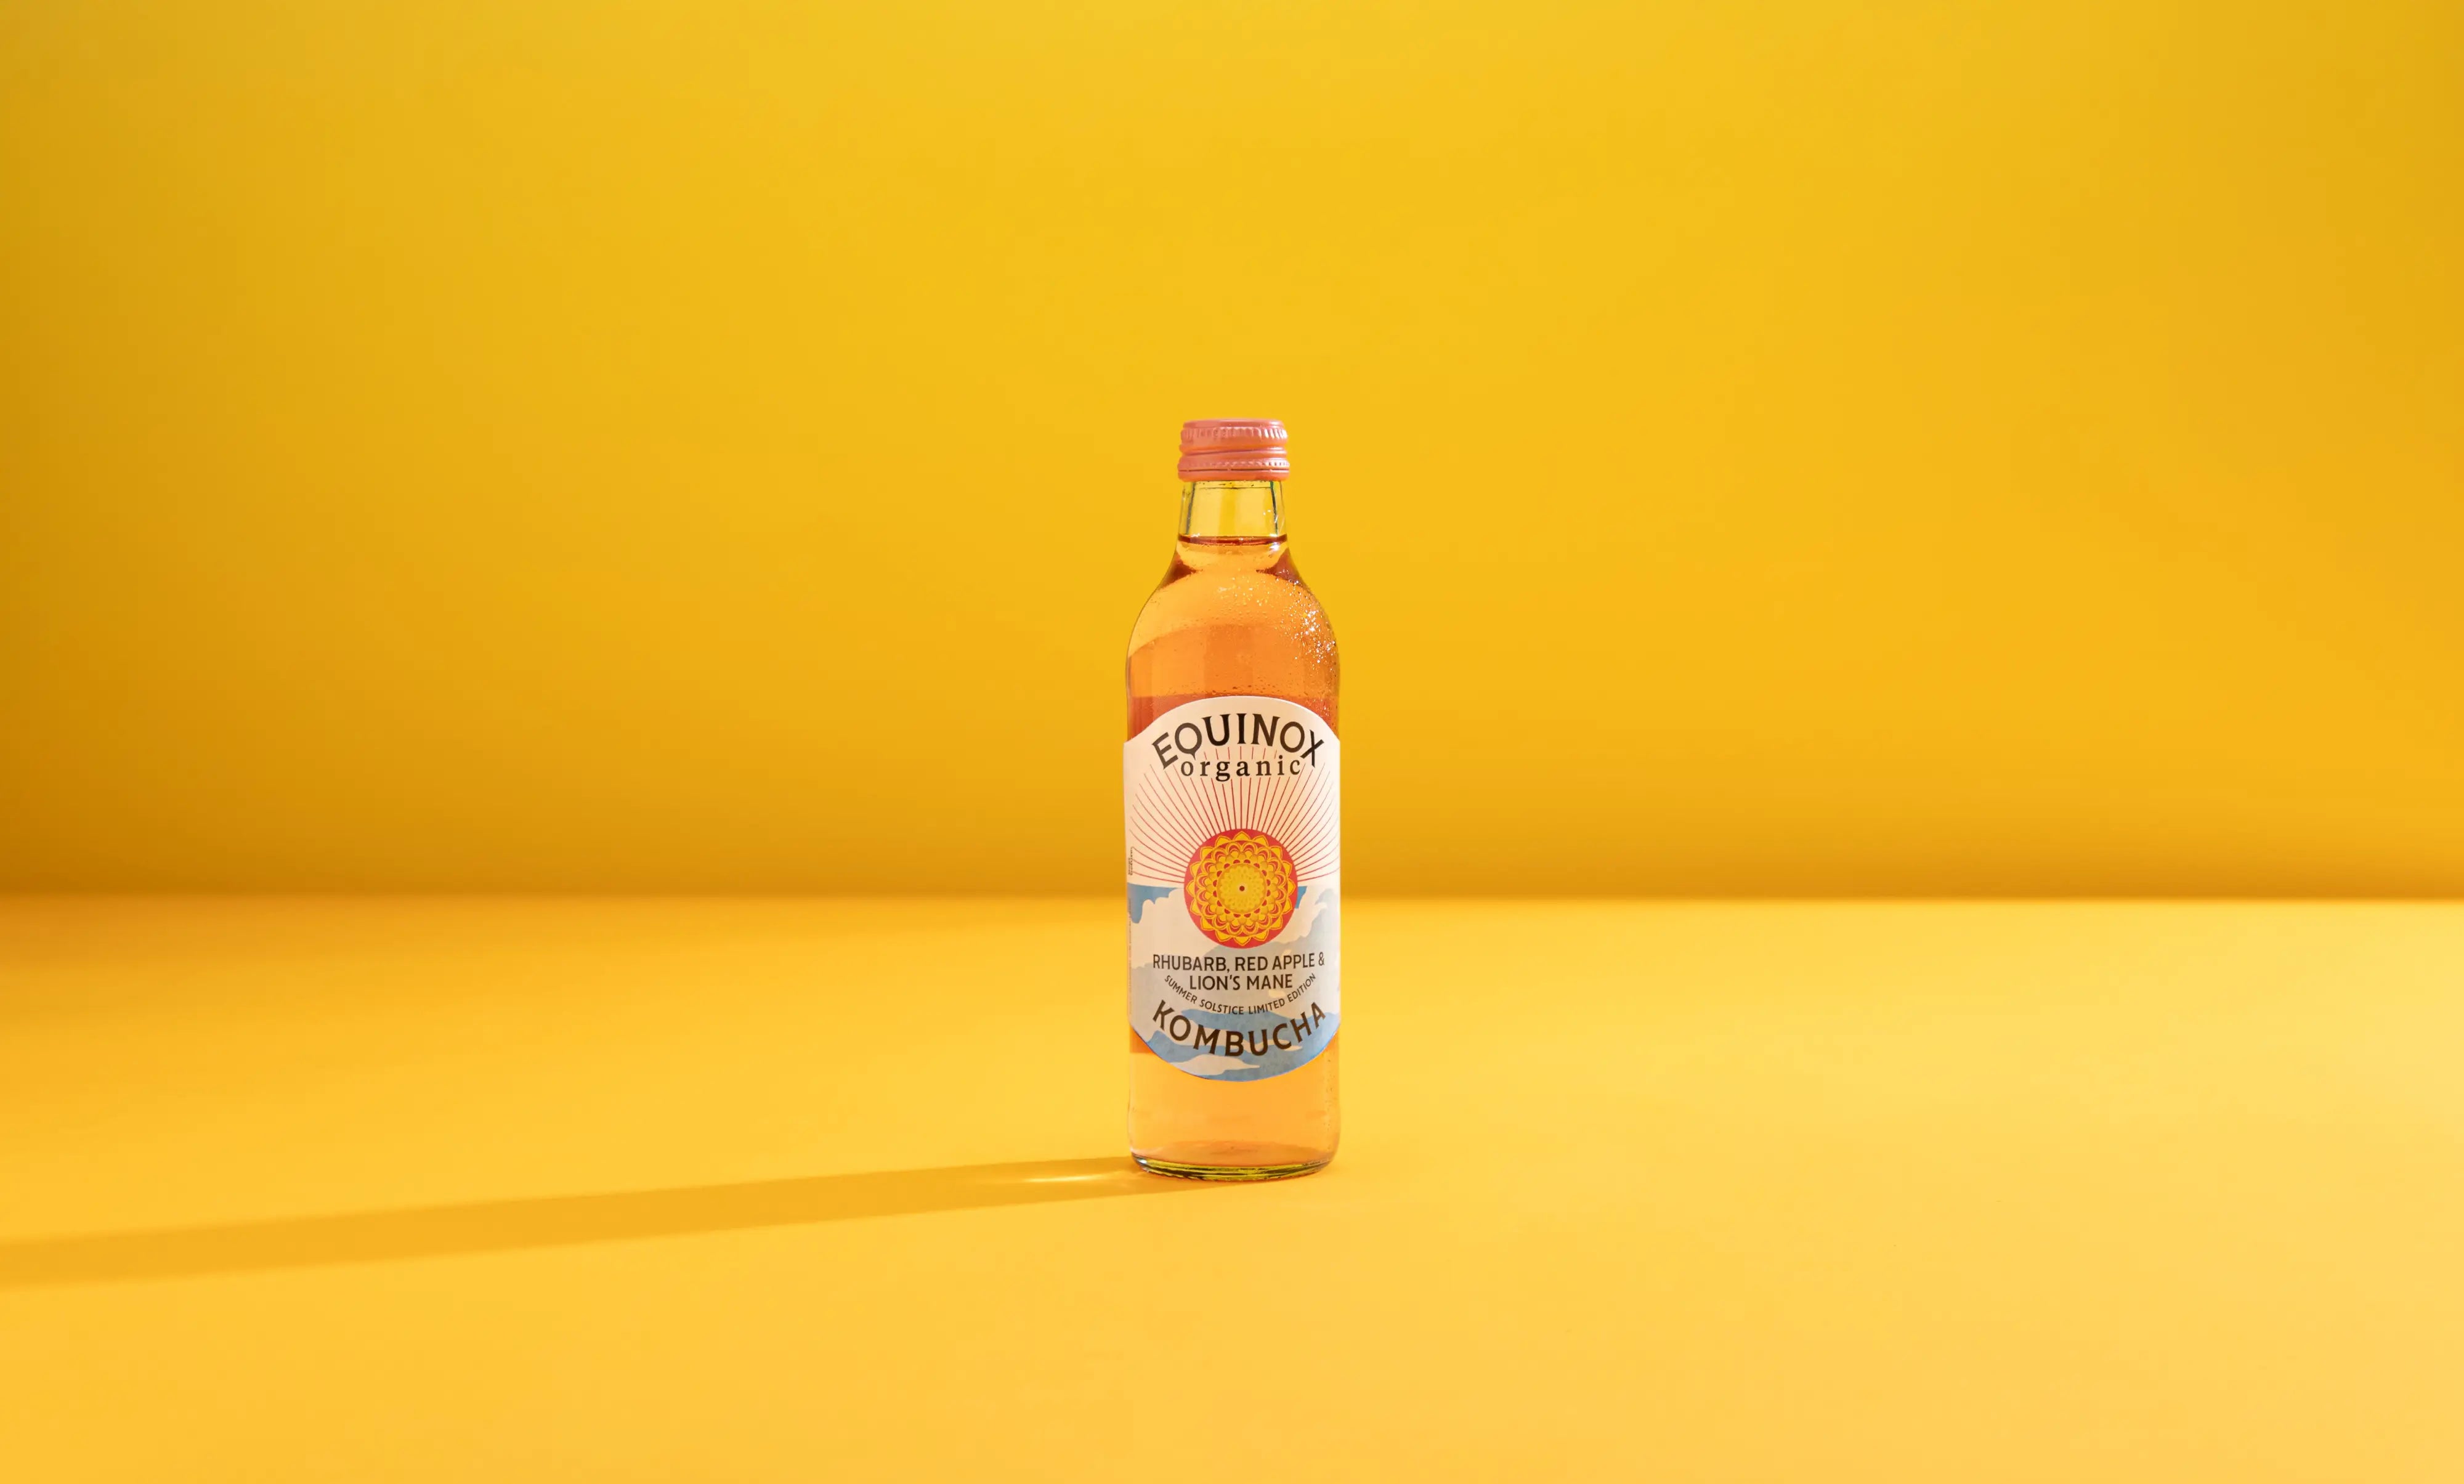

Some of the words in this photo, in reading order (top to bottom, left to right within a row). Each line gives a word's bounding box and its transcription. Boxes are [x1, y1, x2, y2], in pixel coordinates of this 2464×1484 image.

[1151, 713, 1324, 769] EQUINOX
[1180, 755, 1300, 782] organic
[1153, 954, 1230, 973] RHUBARB,
[1235, 956, 1268, 971] RED
[1272, 953, 1315, 970] APPLE
[1318, 952, 1325, 966] &
[1164, 975, 1198, 1004] SUMMER
[1199, 999, 1244, 1015] SOLSTICE
[1249, 998, 1285, 1014] LIMITED
[1287, 973, 1316, 1002] EDITION
[1189, 975, 1241, 991] LION'S
[1247, 974, 1293, 990] MANE
[1152, 999, 1326, 1056] KOMBUCHA
